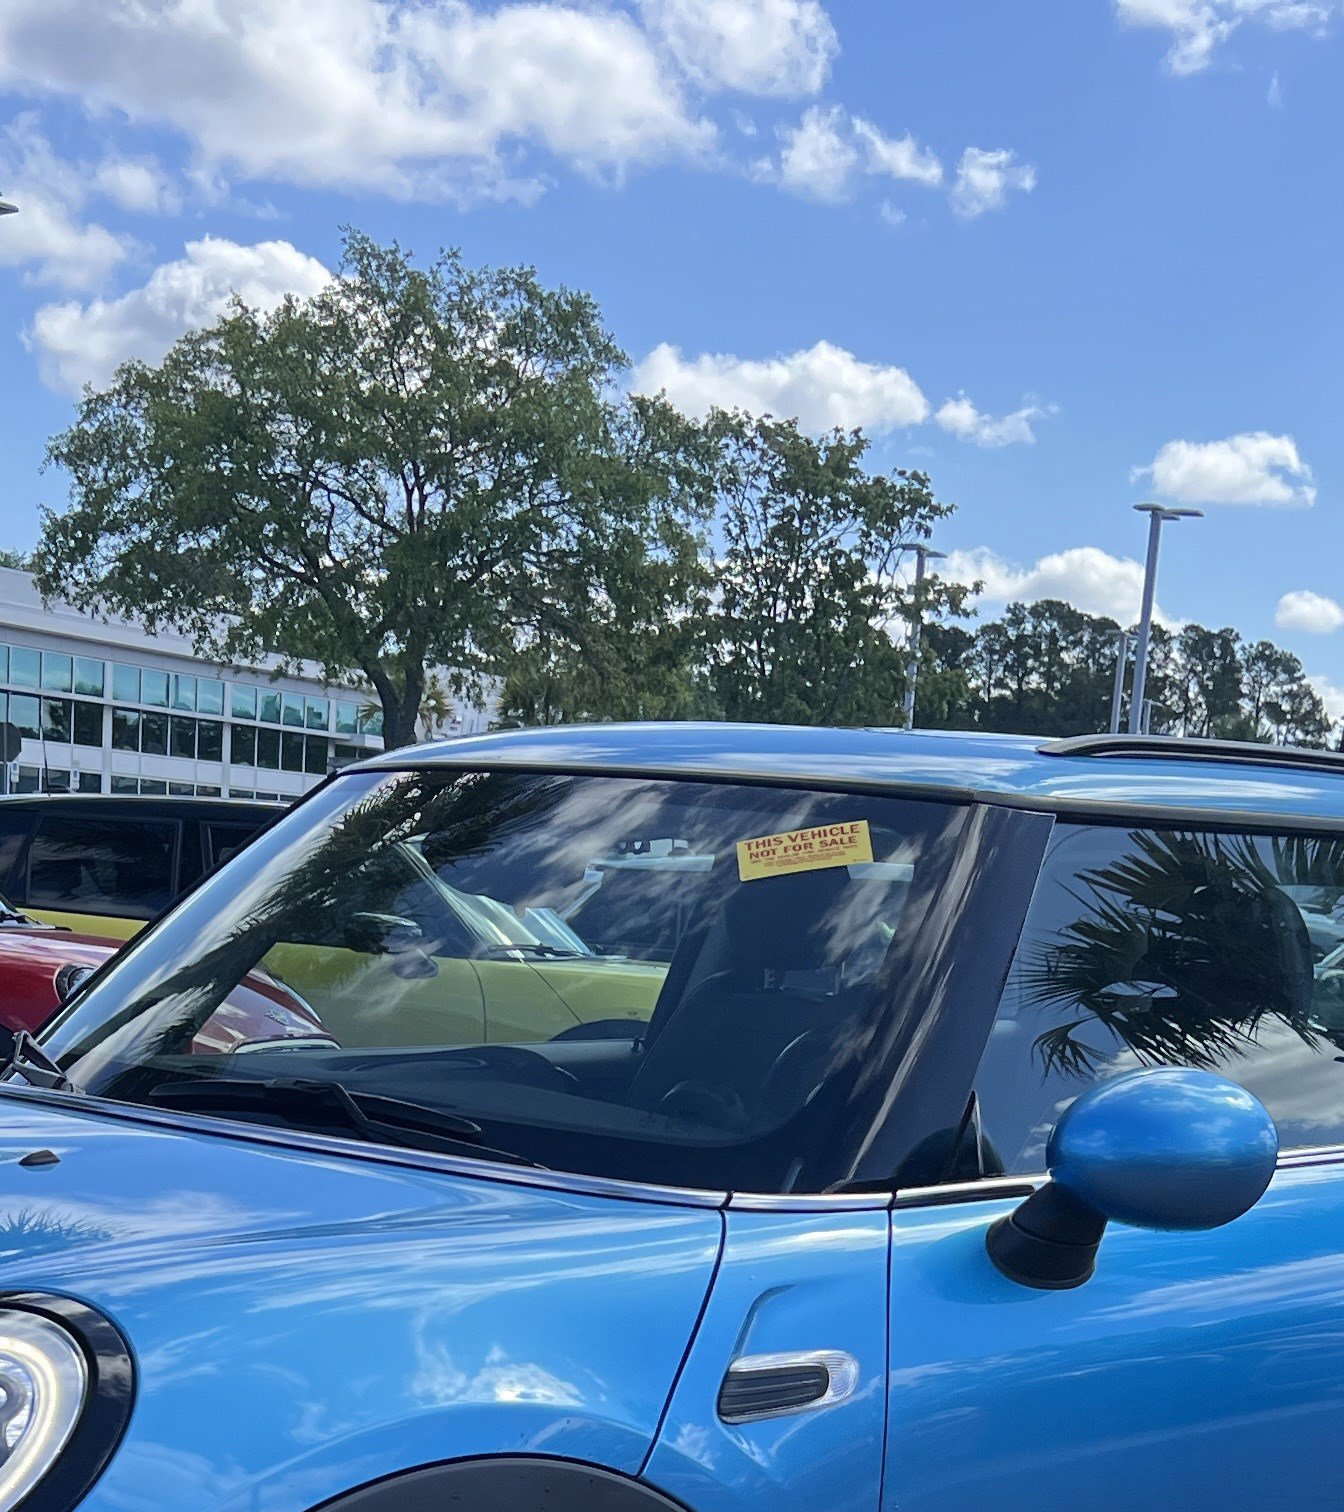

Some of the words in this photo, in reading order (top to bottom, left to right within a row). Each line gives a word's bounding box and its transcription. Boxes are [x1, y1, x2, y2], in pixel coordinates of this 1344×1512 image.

[744, 836, 784, 851] THIS
[787, 823, 861, 843] VEHICLE
[749, 848, 777, 860] NOT
[783, 842, 813, 853] FOR
[819, 836, 858, 848] SALE
